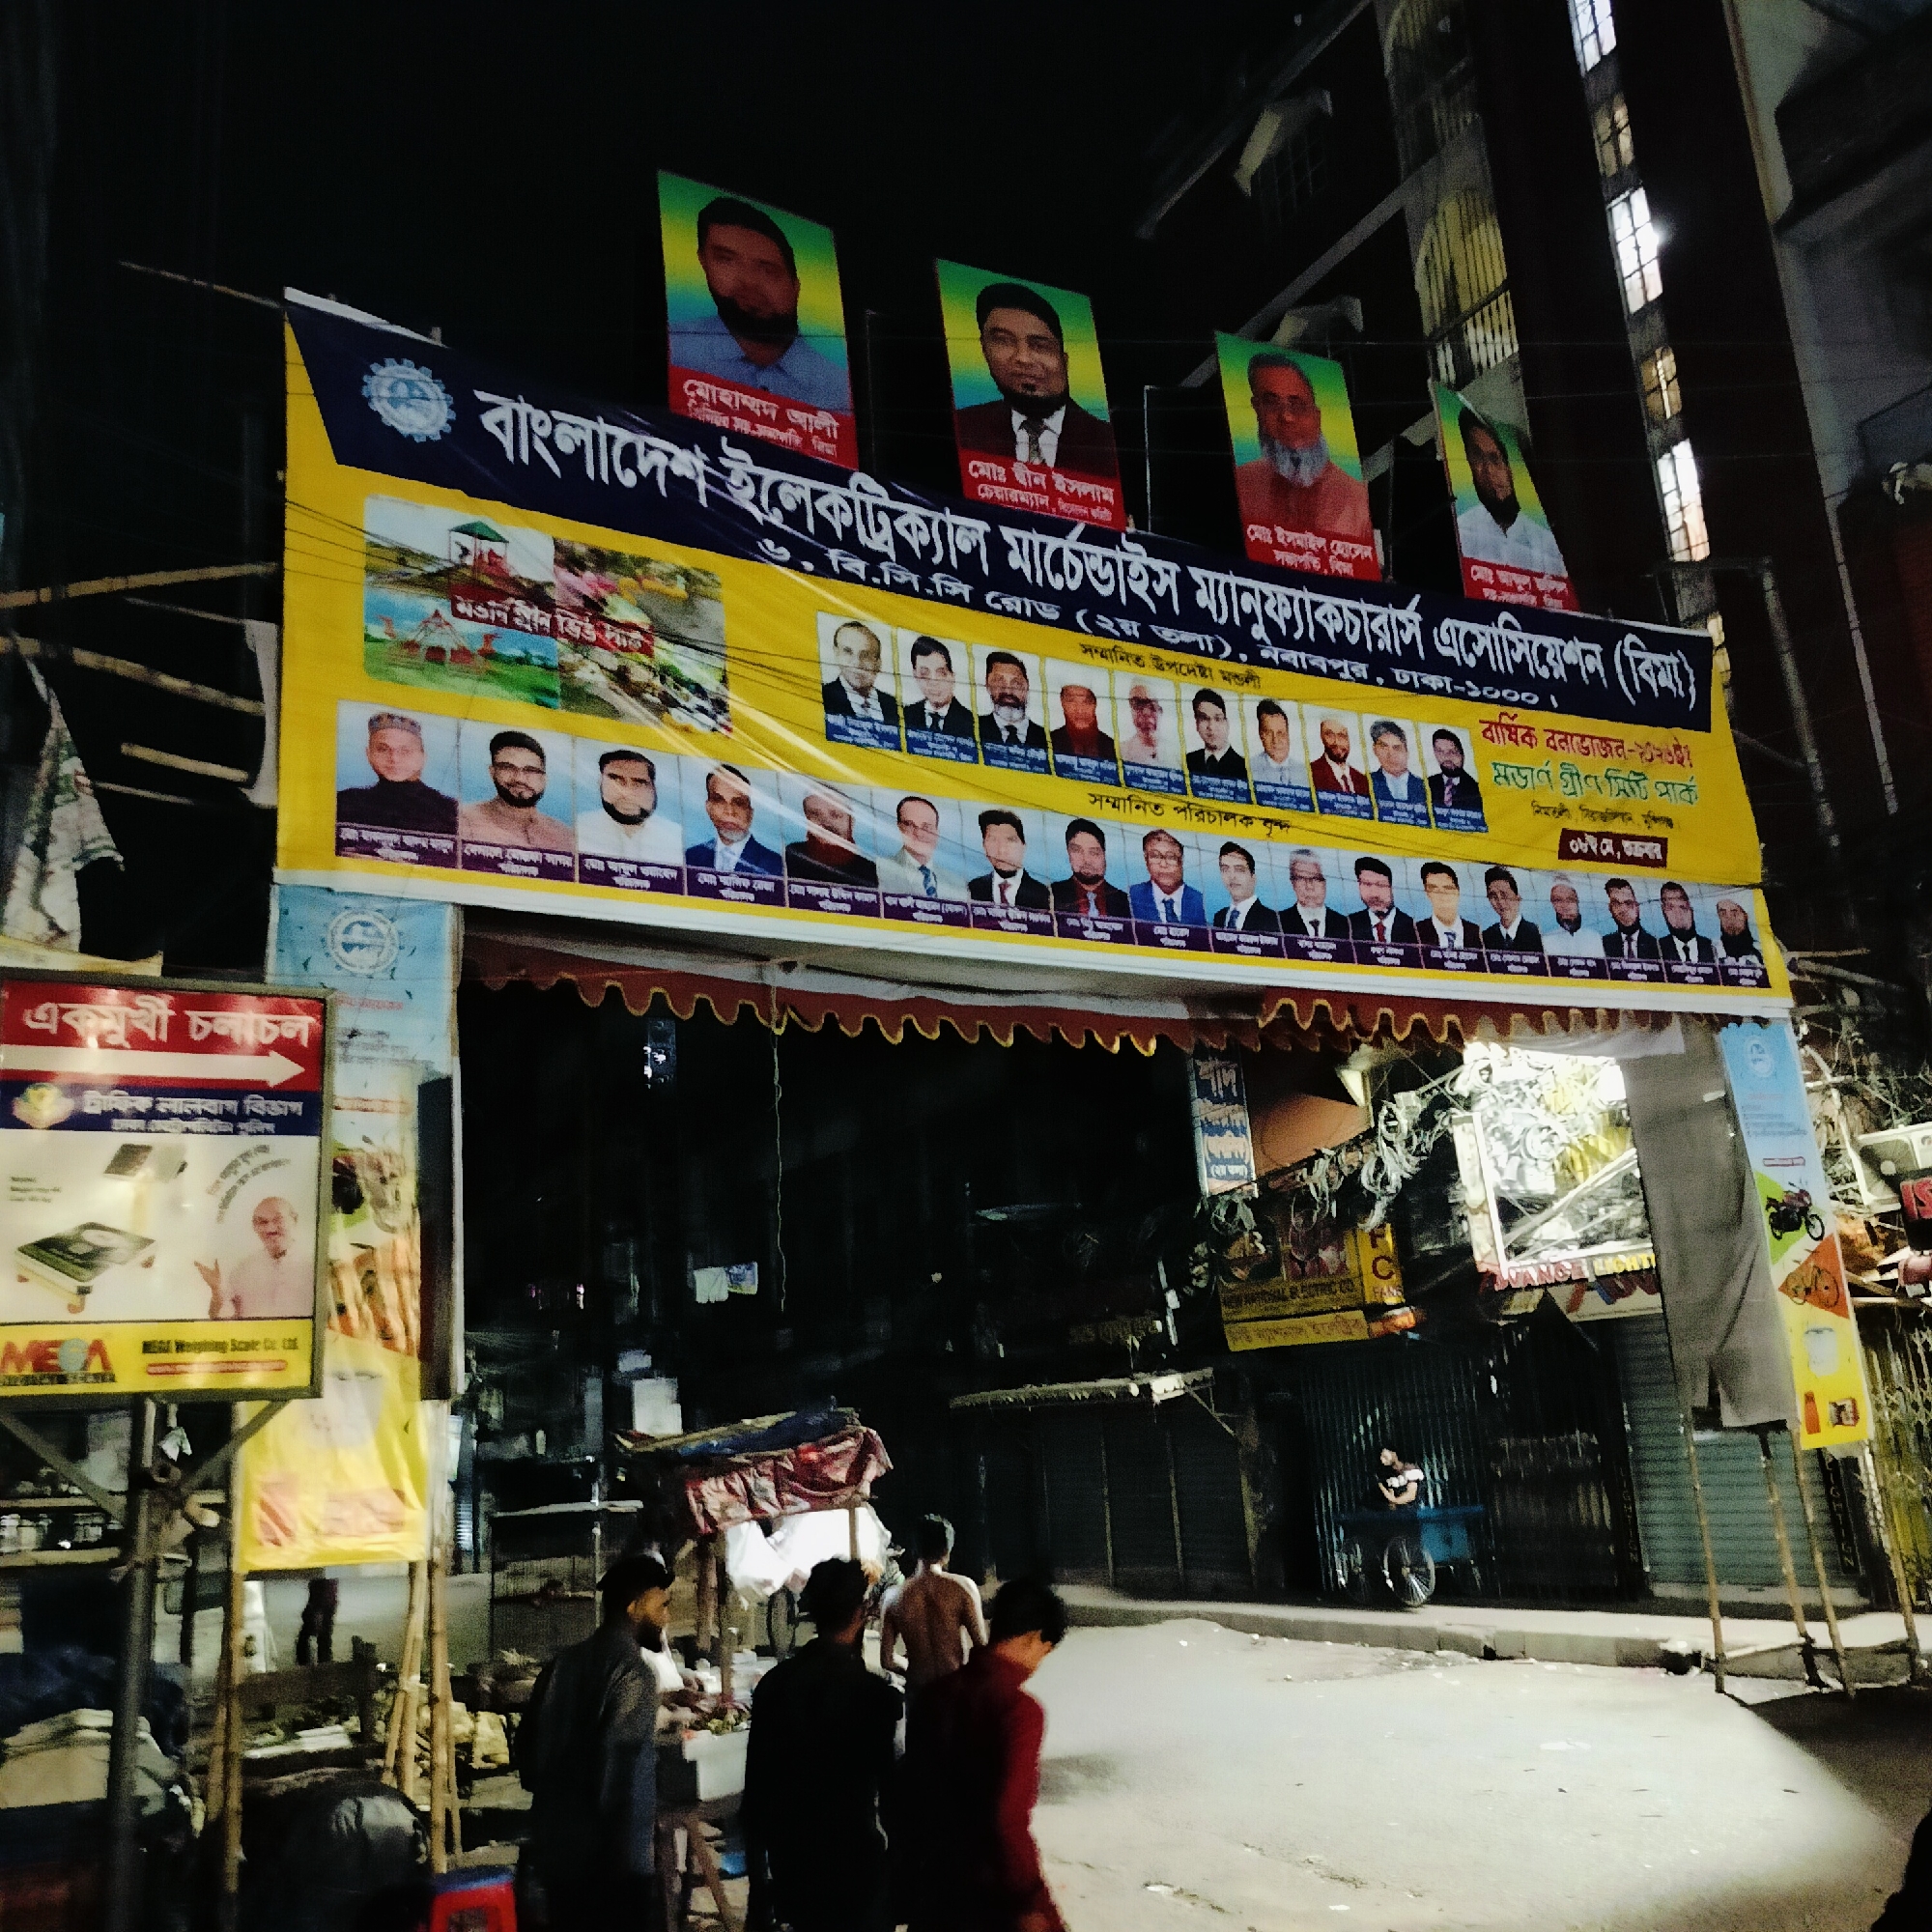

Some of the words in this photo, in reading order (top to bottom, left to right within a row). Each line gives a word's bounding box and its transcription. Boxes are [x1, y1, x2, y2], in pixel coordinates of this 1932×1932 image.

[785, 409, 839, 440] আলী
[1051, 470, 1115, 505] ইসলাম
[473, 388, 713, 508] বাংলাদেশ
[718, 436, 990, 577] ইলেকট্রিক্যাল
[1186, 566, 1423, 660] ম্যানুফ্যাকচারার্স
[1434, 611, 1608, 689] এসোসিয়েশন
[1614, 633, 1696, 711] (বিমা)
[984, 590, 1061, 621] রোড
[1479, 712, 1537, 749] বার্ষিক
[1654, 776, 1698, 805] পার্ক
[1088, 792, 1164, 816] সম্মানিত
[1174, 802, 1254, 828] পরিচালক
[23, 994, 177, 1049] একমুখী
[183, 1010, 317, 1049] চলাচল
[1, 1338, 113, 1373] MEGA
